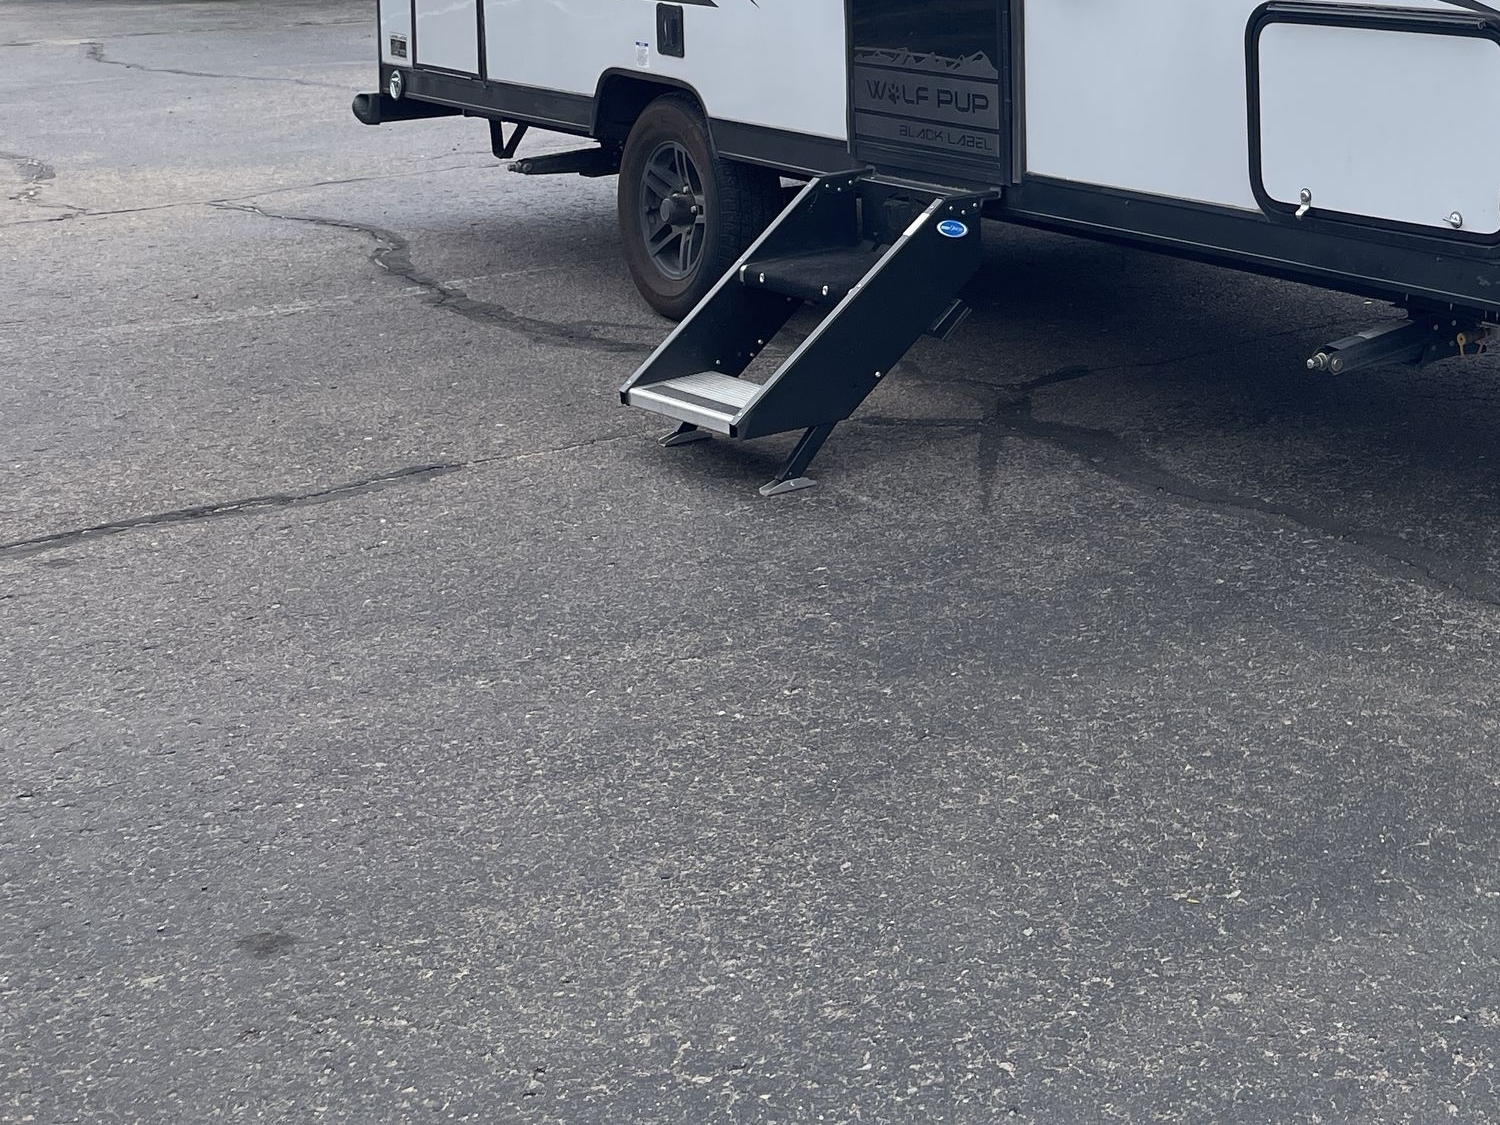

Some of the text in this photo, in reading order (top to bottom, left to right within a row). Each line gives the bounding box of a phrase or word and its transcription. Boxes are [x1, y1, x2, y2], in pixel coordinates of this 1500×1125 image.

[936, 88, 989, 114] PUP
[899, 125, 993, 151] BLACK LABEL
